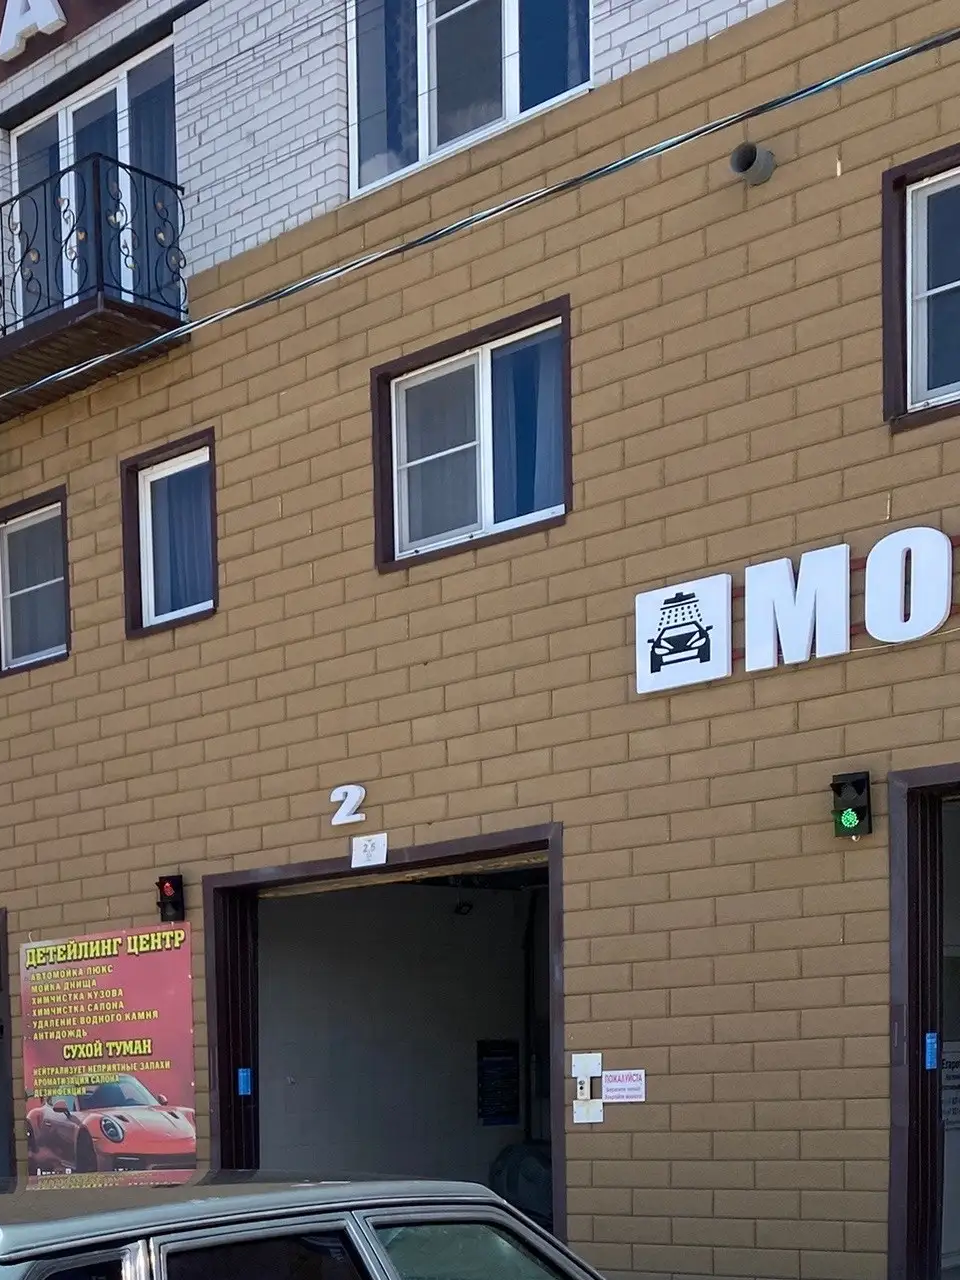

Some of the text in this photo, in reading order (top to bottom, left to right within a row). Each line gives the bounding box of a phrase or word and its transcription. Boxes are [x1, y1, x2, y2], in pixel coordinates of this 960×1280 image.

[745, 526, 953, 672] МО
[330, 785, 366, 826] 2
[25, 930, 186, 968] ДЕТЕЙЛИНГ ЦЕНТР
[63, 979, 97, 991] ДНИЩА
[31, 988, 124, 1005] ХИМЧИСТКА КУЗОВА
[32, 1000, 125, 1017] ХИМЧИСТКА САЛОНА
[32, 1010, 159, 1029] УДАЛЕНИЕ ВОДНОГО КАМНЯ
[33, 1029, 88, 1041] АНТИДОЖДЬ
[63, 1039, 153, 1060] СУХОЙ ТУМАН
[87, 1062, 138, 1073] НЕПРИЯТНЫЕ
[139, 1060, 172, 1071] ЗАПАХИ
[90, 1074, 120, 1083] САЛОНА
